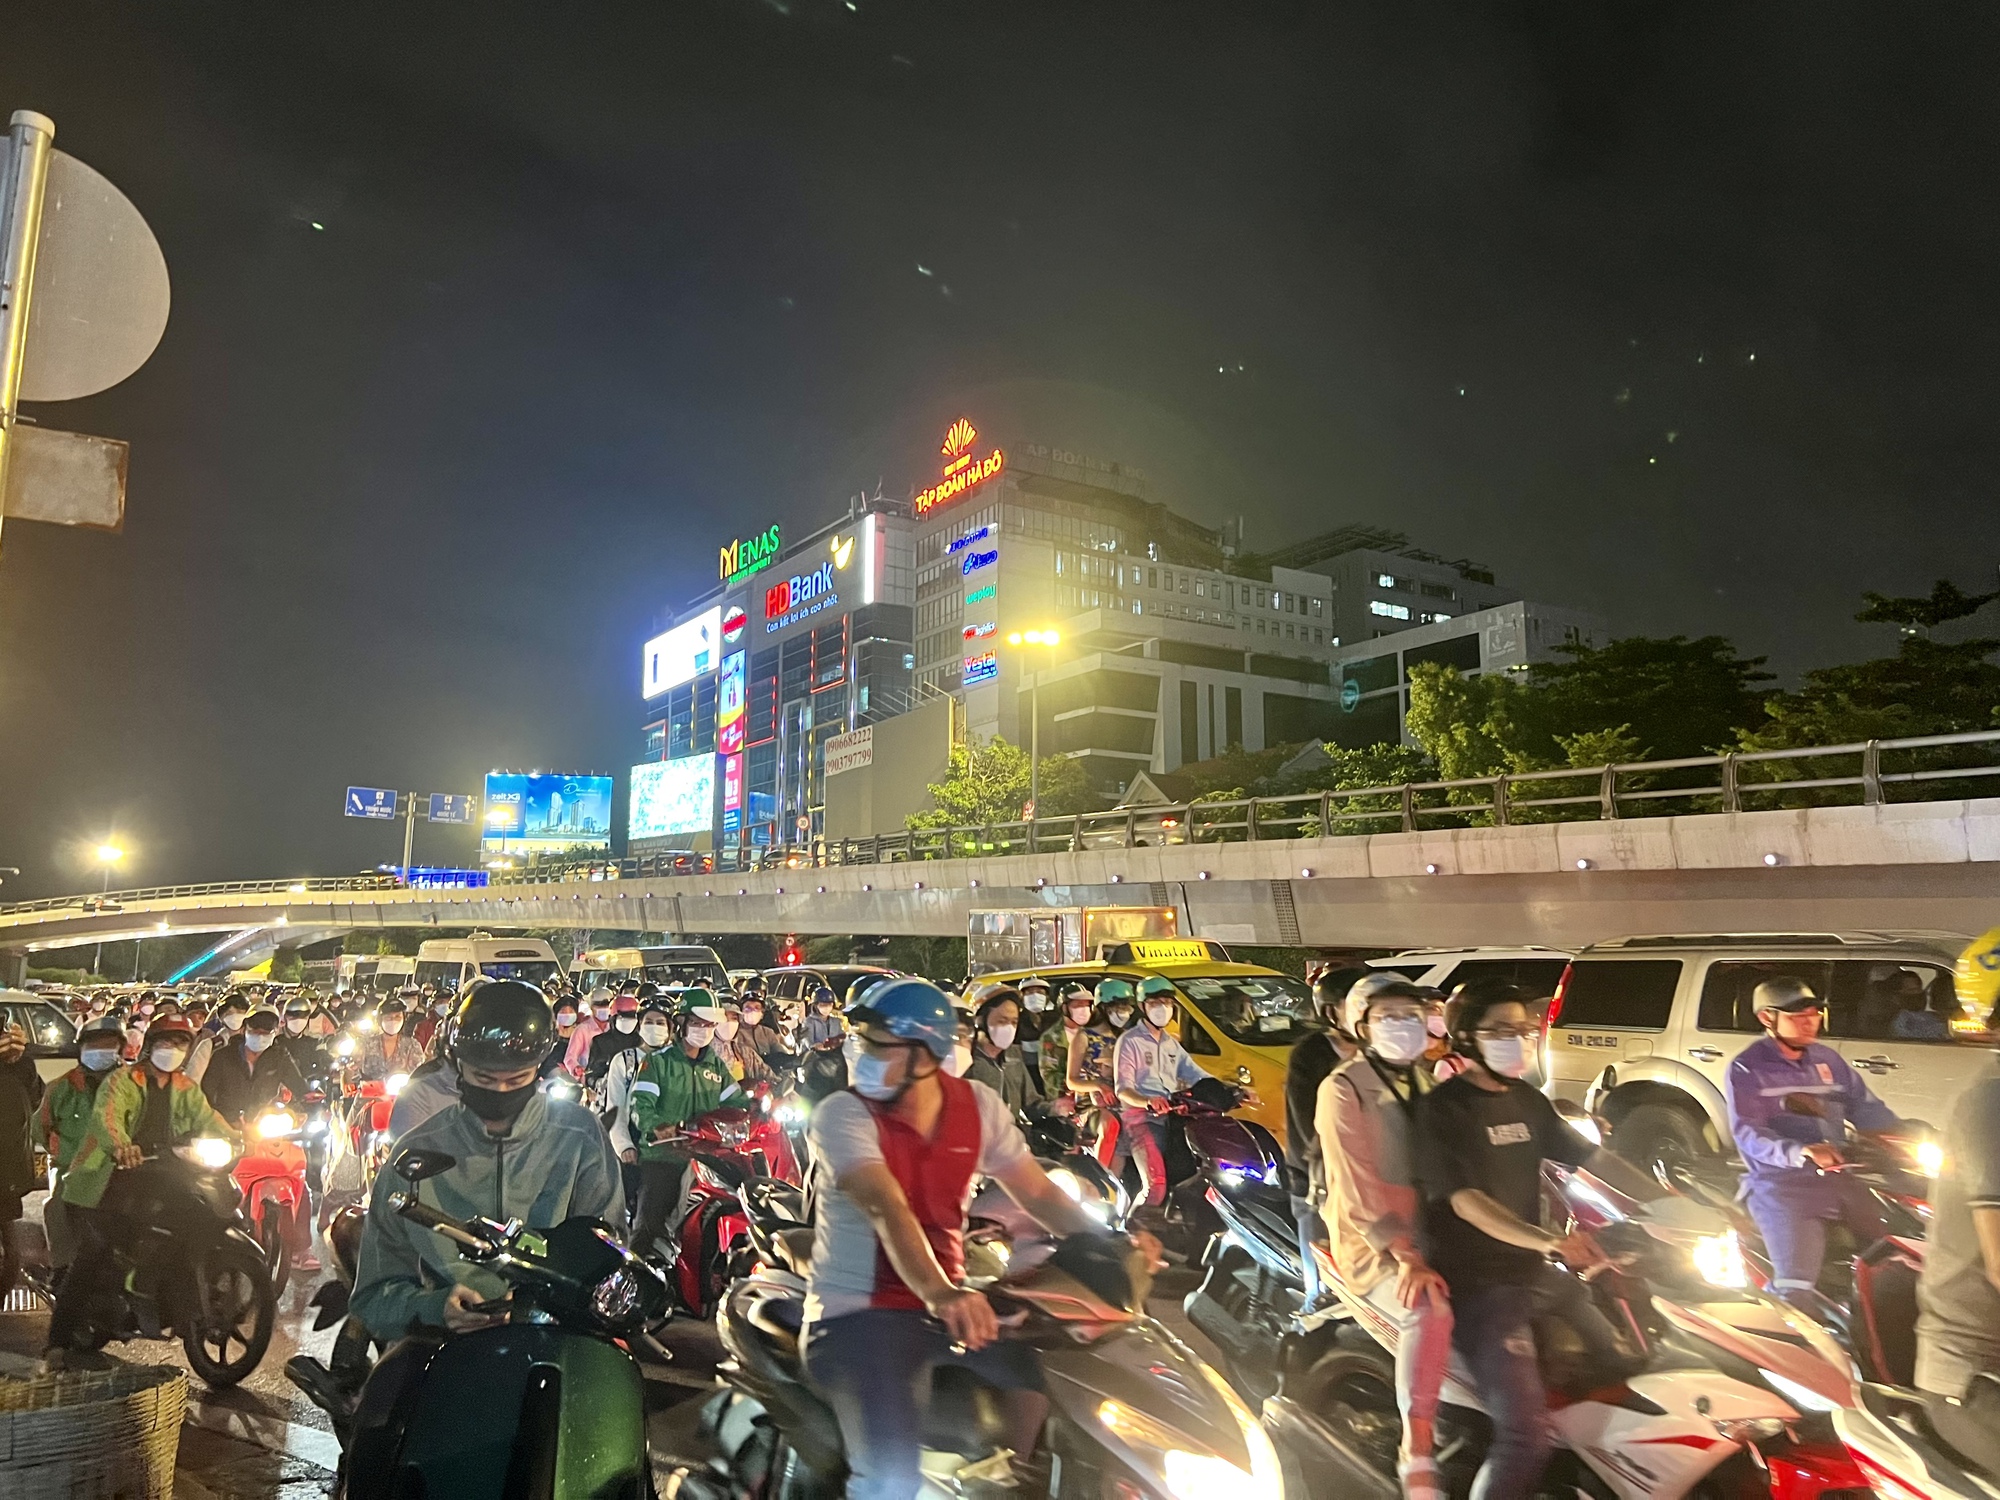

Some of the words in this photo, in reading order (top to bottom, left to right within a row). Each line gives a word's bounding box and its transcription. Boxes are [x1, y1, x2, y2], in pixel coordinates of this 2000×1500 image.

[915, 489, 936, 513] TẬP
[966, 460, 984, 487] HÀ
[719, 524, 780, 580] MENAS
[765, 561, 834, 619] HDBank
[810, 602, 822, 614] cao
[1136, 945, 1203, 958] Vinataxi
